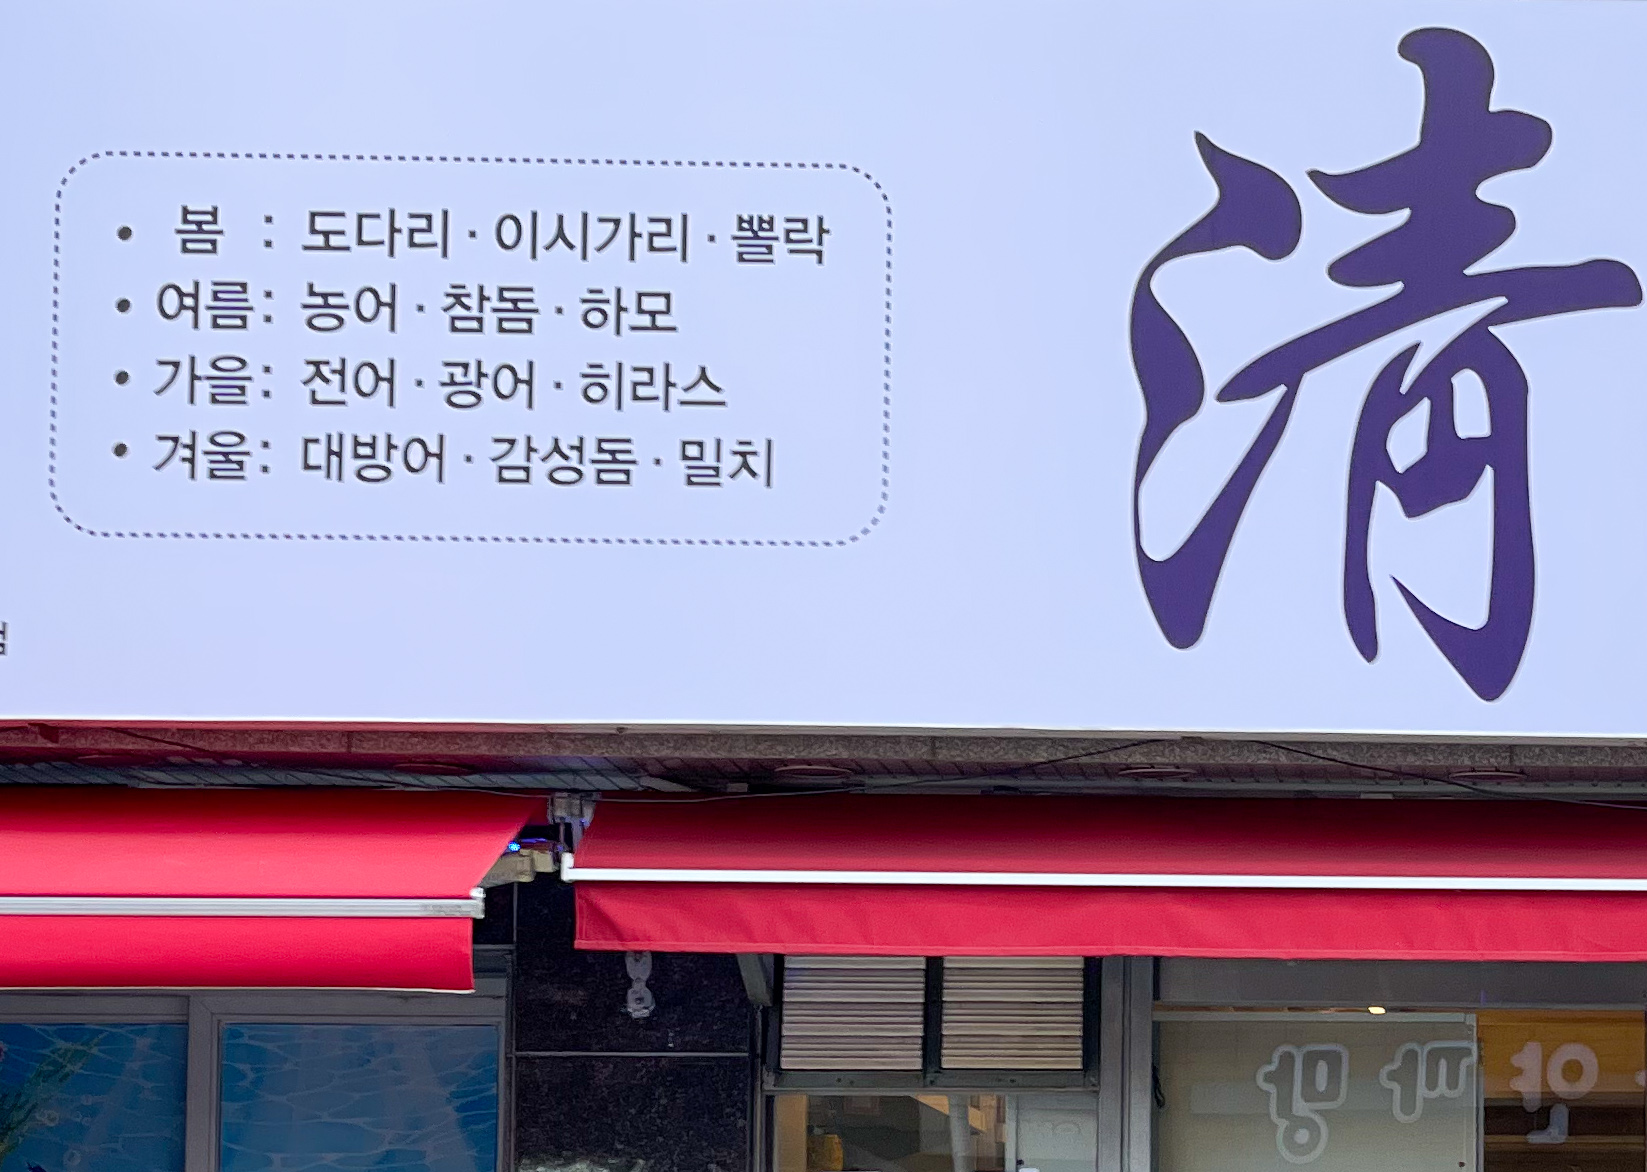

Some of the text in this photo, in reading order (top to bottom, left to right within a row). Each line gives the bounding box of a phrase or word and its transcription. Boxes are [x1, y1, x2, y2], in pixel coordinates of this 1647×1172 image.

[175, 205, 224, 254] 봄
[302, 208, 448, 259] 도다리
[496, 211, 687, 263] 이시가리
[731, 215, 830, 264] 뽈락
[301, 282, 396, 333] 농어
[441, 284, 539, 334] 참돔
[580, 287, 677, 336] 하모
[302, 357, 395, 408] 전어
[439, 359, 533, 410] 광어
[580, 362, 726, 412] 히라스
[1130, 27, 1643, 702] 清
[303, 432, 444, 483] 대방어
[490, 435, 638, 486] 감성돔
[681, 438, 772, 488] 밀치
